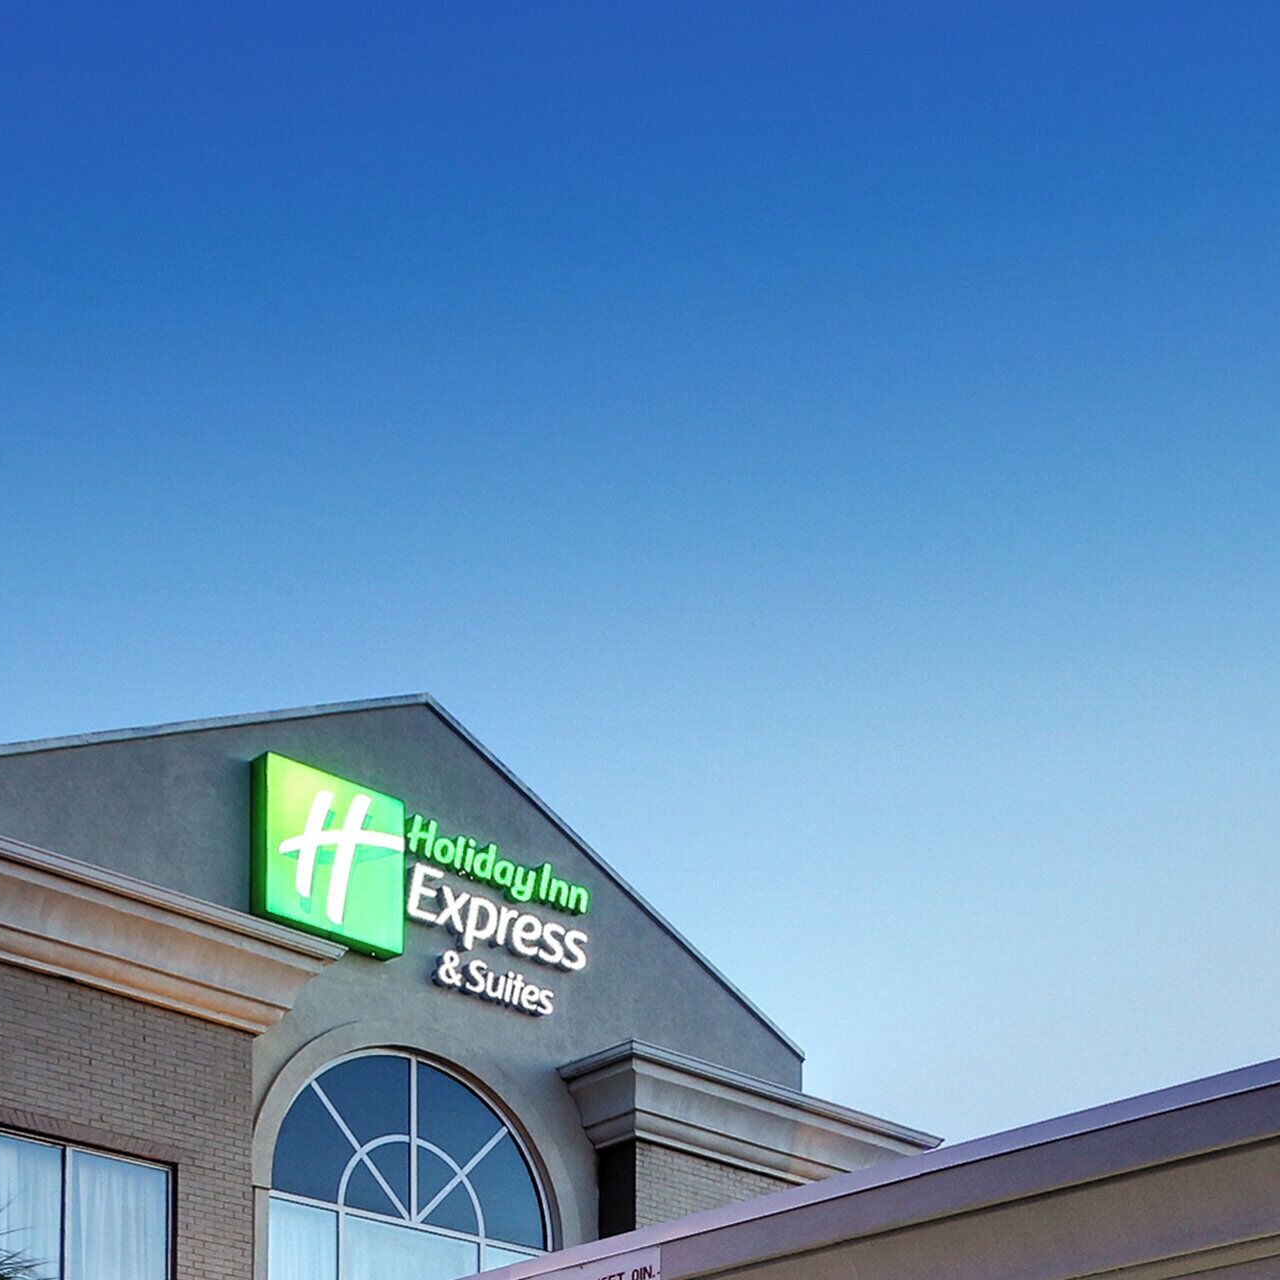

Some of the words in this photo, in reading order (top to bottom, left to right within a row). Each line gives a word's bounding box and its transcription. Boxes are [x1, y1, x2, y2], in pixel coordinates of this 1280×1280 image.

[407, 814, 536, 902] Holiday
[539, 863, 589, 913] Inn
[407, 862, 588, 971] Express
[437, 950, 462, 987] &
[465, 959, 554, 1015] Suites
